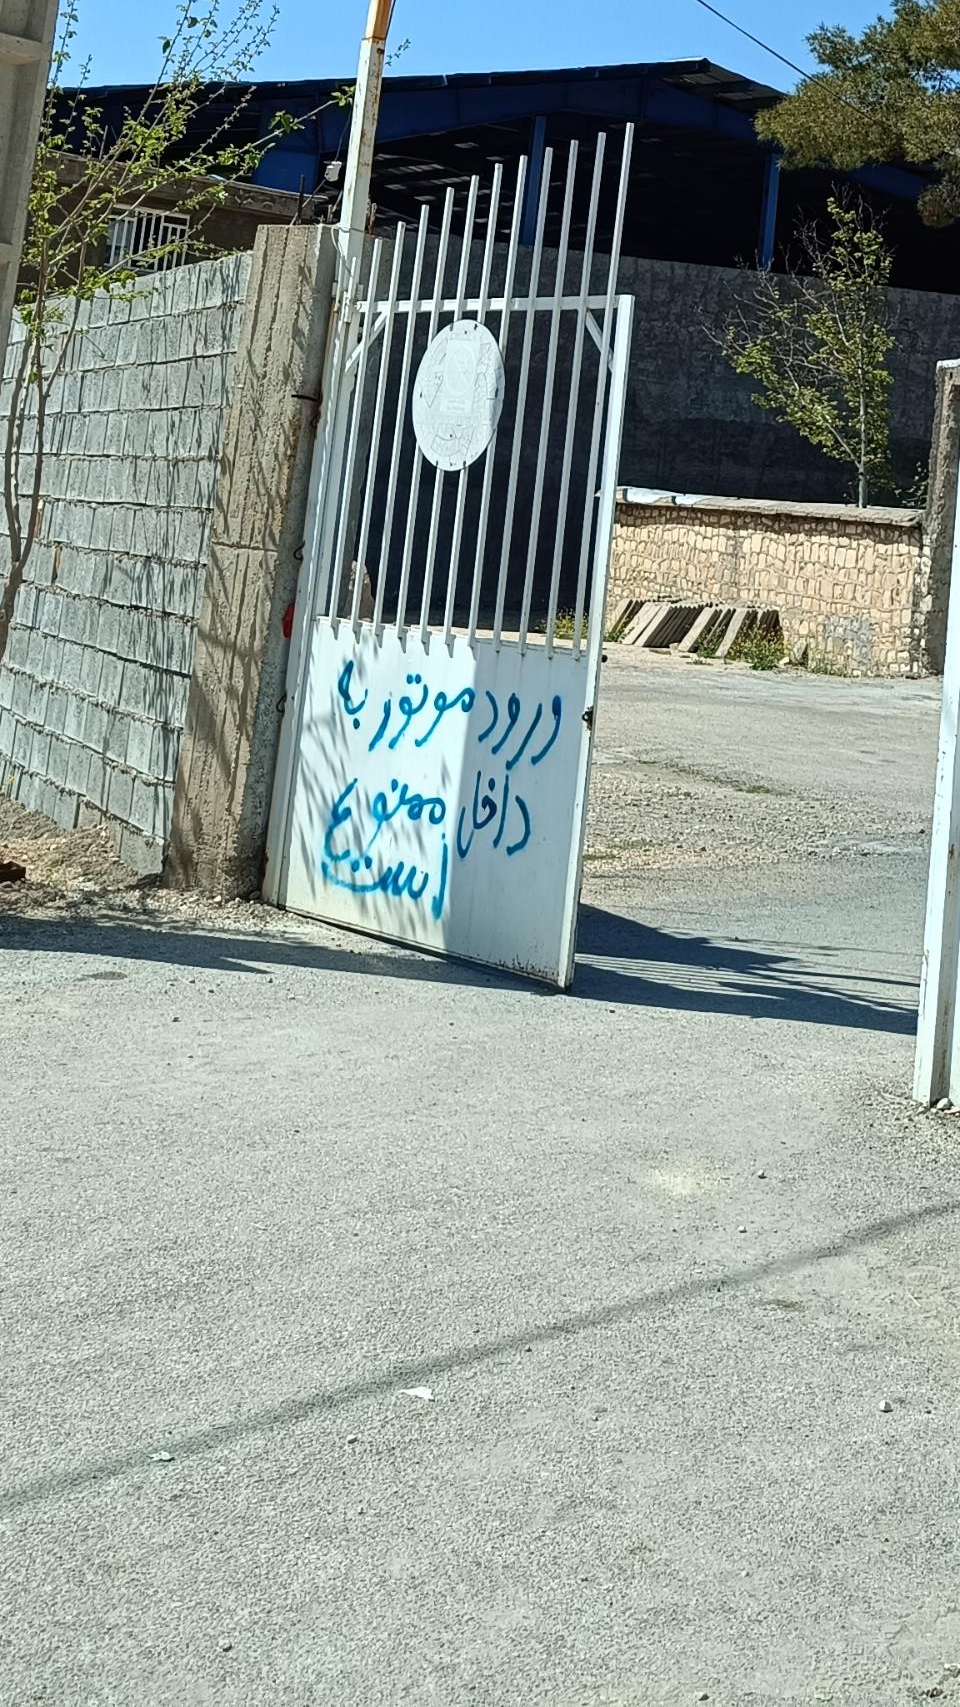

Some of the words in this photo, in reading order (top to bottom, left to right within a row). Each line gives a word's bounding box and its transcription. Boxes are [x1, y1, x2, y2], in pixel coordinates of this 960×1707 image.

[337, 660, 368, 730] به
[368, 673, 475, 752] موتور
[478, 690, 562, 770] ورود
[325, 776, 446, 861] ممنوع
[457, 770, 531, 859] داخل
[321, 841, 449, 920] است
